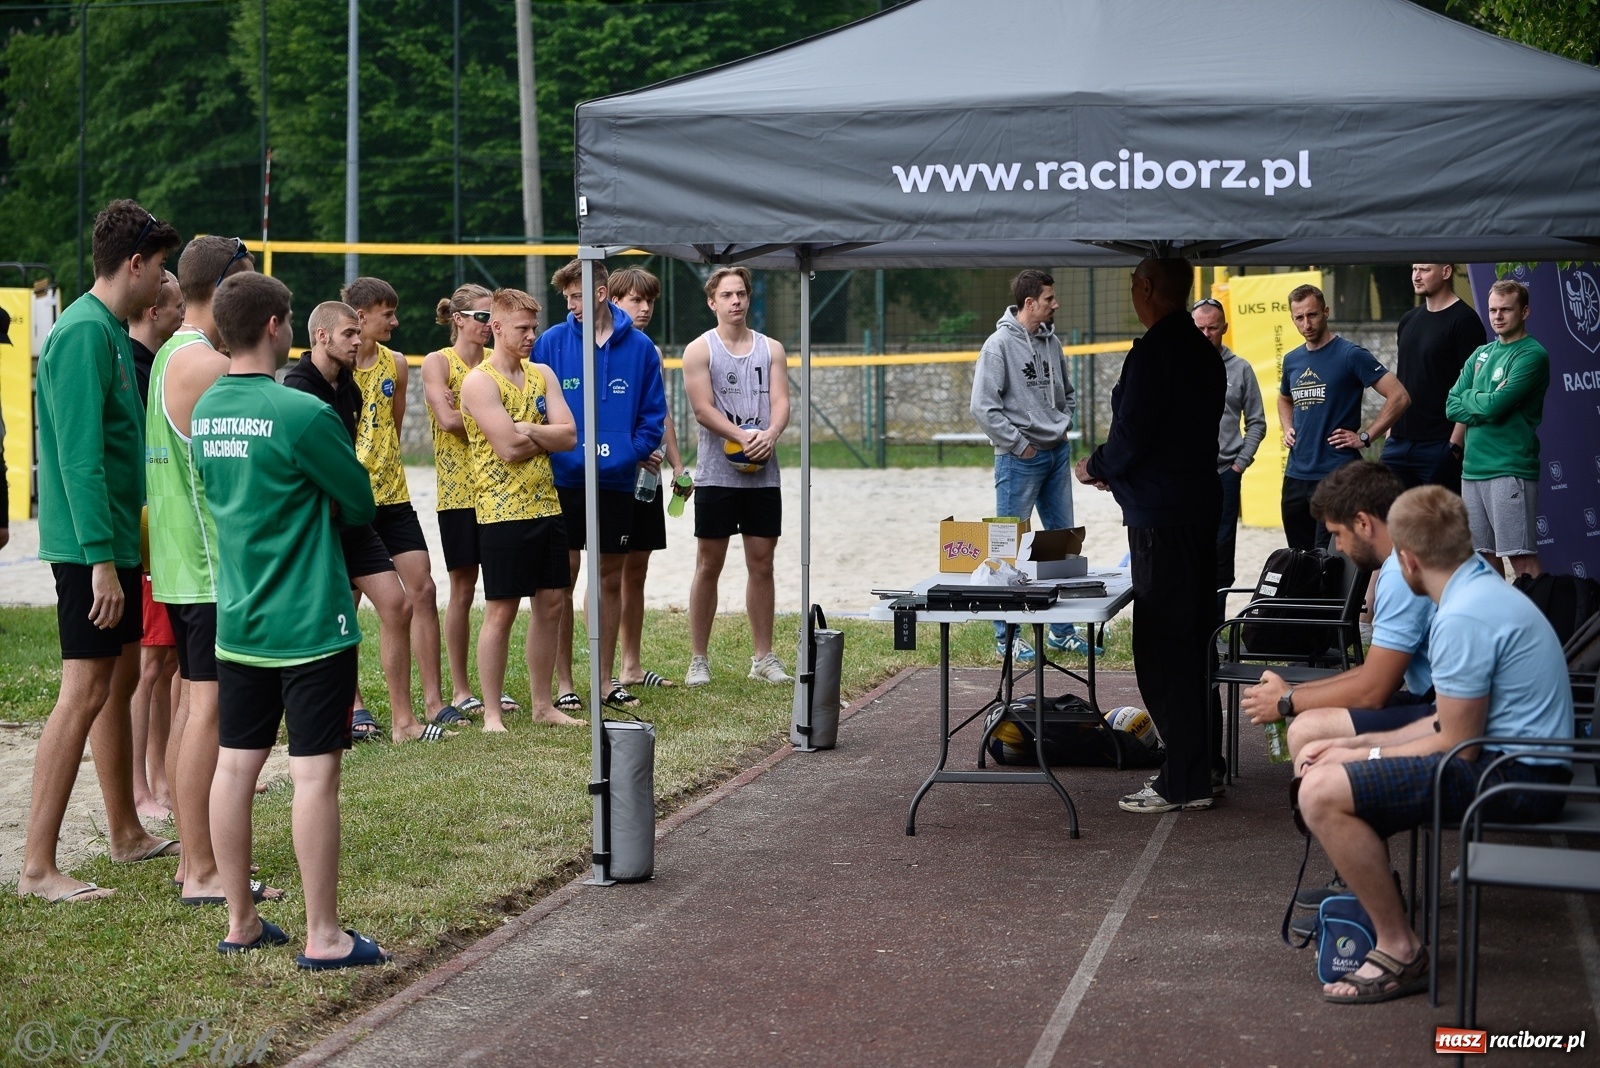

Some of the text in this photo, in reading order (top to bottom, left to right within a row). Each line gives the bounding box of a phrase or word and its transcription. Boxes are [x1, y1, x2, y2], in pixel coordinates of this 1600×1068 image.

[891, 148, 1312, 196] www.raciborz.pl
[1238, 303, 1266, 315] UKS
[755, 366, 763, 385] 1
[369, 402, 379, 428] 2
[211, 417, 274, 438] SIATKARSKI
[202, 436, 249, 458] RACIBÓRZ
[337, 613, 348, 636] 2
[1129, 713, 1151, 737] MIKAS
